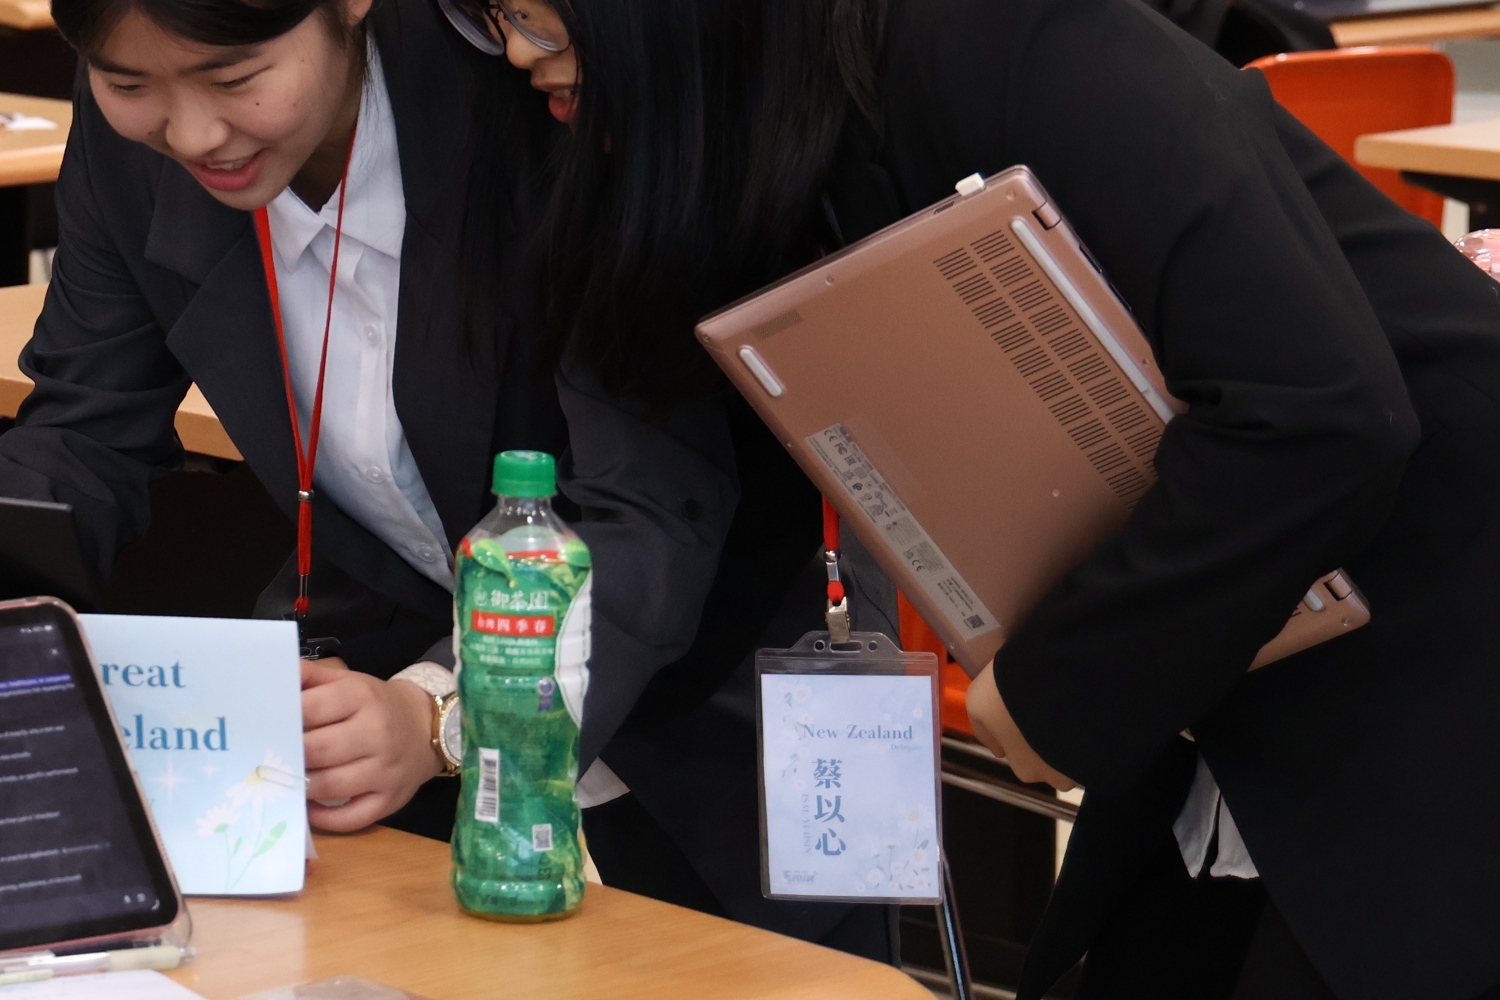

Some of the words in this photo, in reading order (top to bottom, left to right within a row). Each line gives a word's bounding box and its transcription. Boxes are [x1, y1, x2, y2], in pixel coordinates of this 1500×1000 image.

[100, 660, 187, 688] reat
[119, 713, 230, 751] land
[803, 724, 840, 740] New
[846, 724, 913, 740] Zealand
[811, 757, 847, 856] 蔡以心
